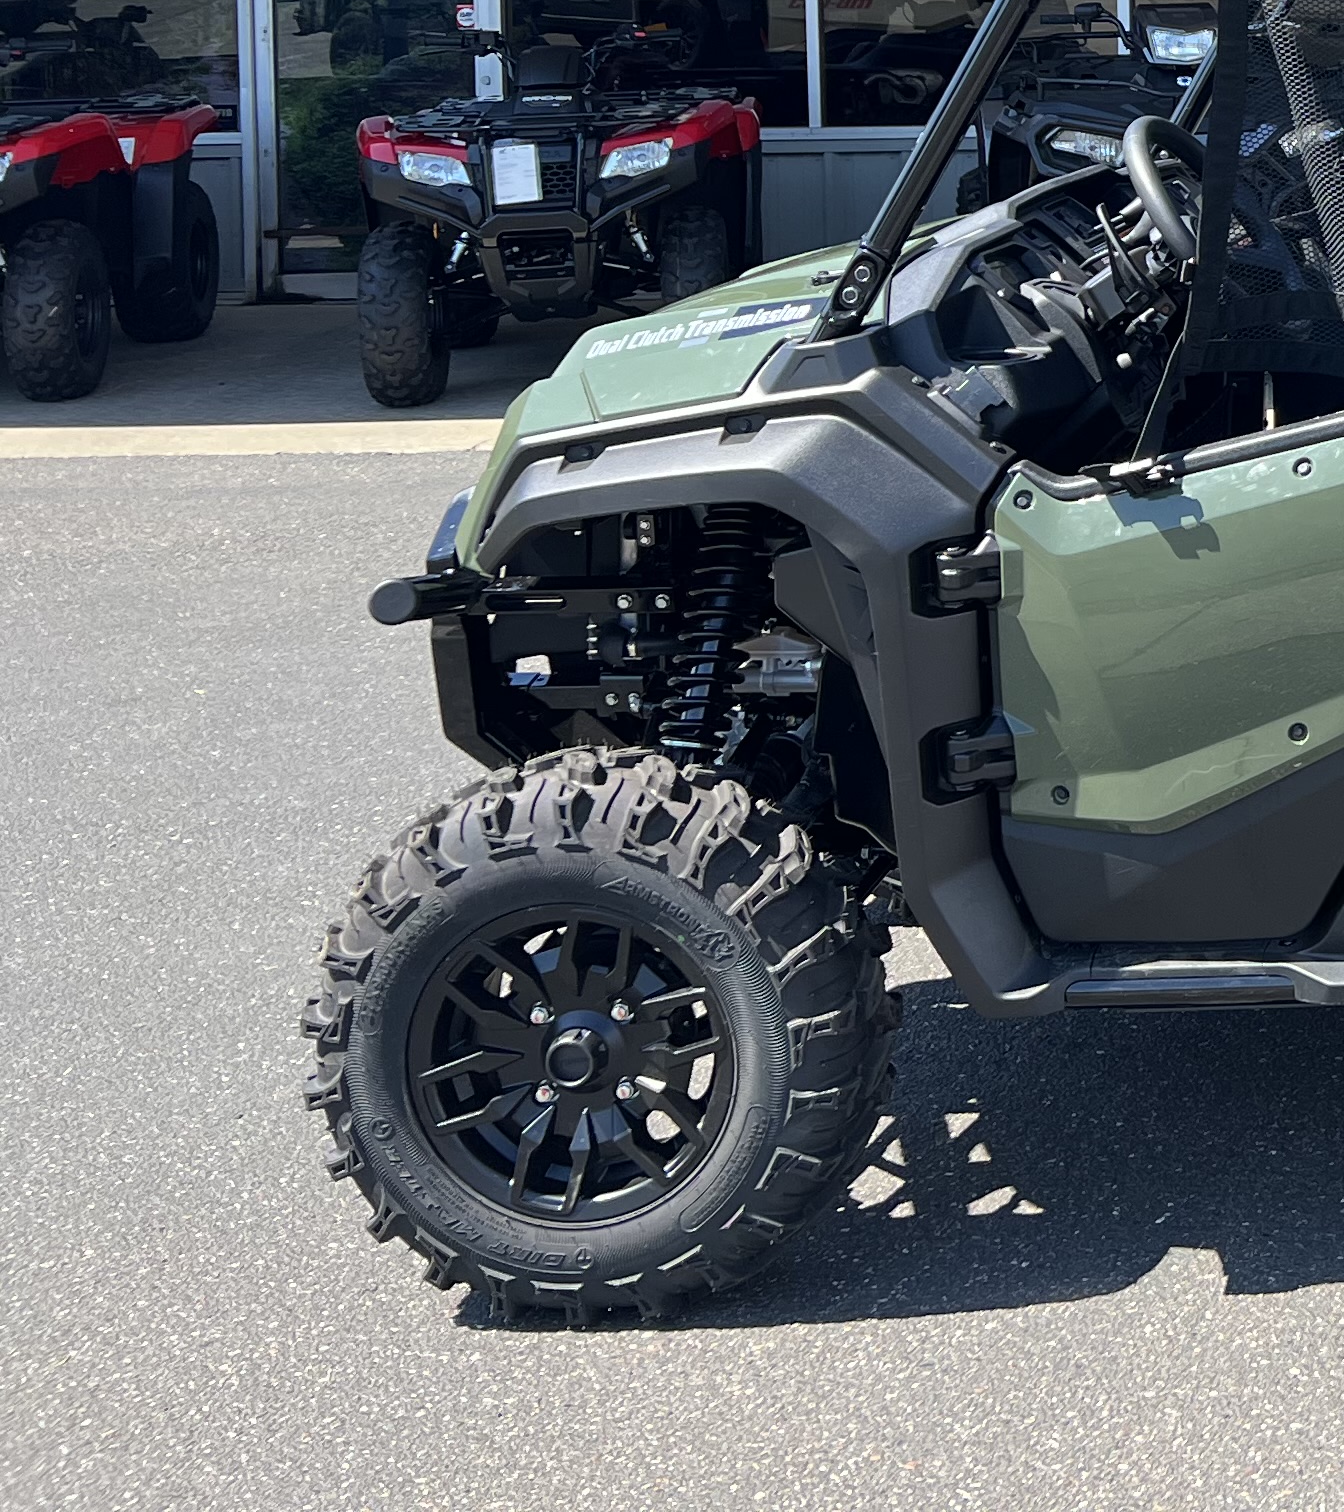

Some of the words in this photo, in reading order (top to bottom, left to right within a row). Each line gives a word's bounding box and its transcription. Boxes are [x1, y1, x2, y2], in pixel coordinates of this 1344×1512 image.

[585, 334, 629, 359] Dual
[625, 323, 686, 350] Clutch
[683, 303, 812, 339] Transmission
